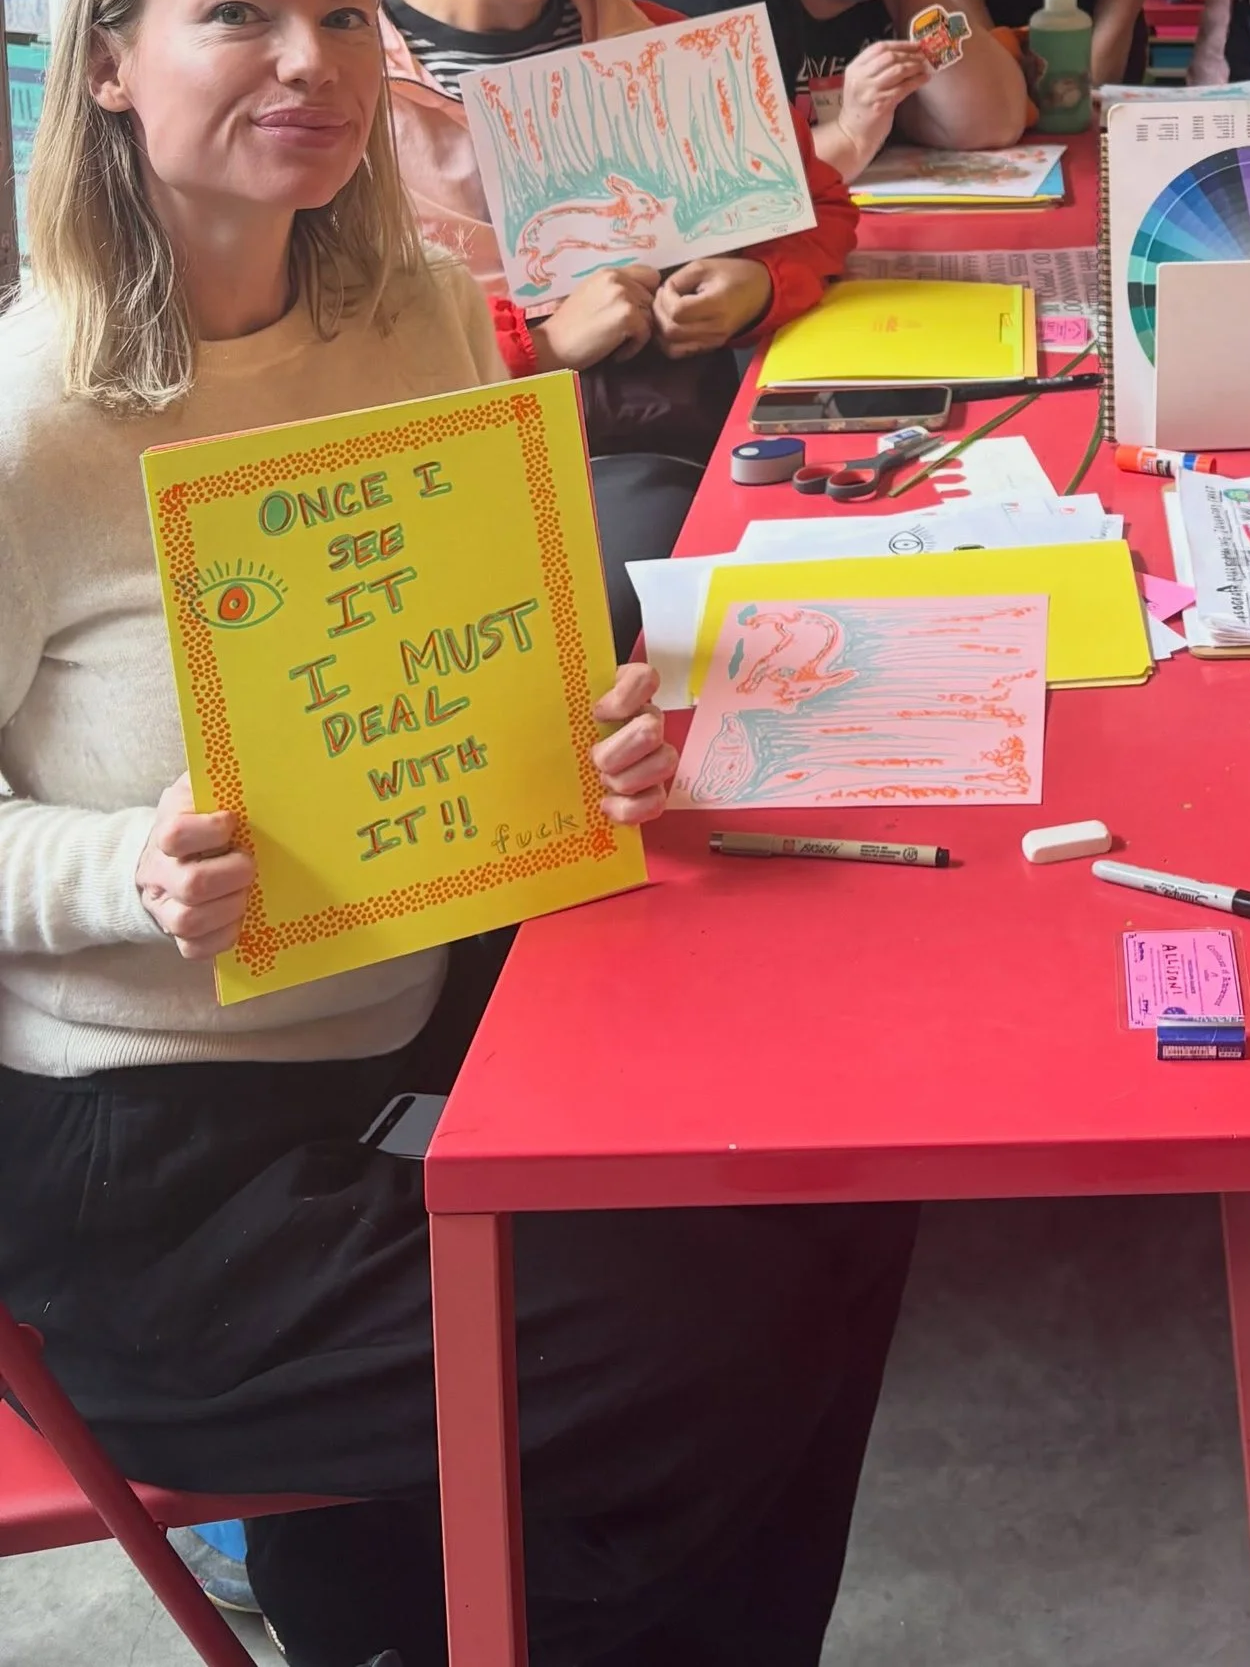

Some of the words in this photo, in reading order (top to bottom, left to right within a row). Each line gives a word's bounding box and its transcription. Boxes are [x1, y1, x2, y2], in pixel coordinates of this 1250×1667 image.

[259, 472, 392, 536] ONCE
[413, 462, 452, 499] I
[328, 524, 405, 571] SEE
[327, 567, 417, 638] IT
[290, 655, 349, 713] I
[401, 598, 539, 685] MUST
[322, 686, 470, 758] DEAL
[367, 737, 488, 801] WITH
[490, 810, 580, 855] fuck
